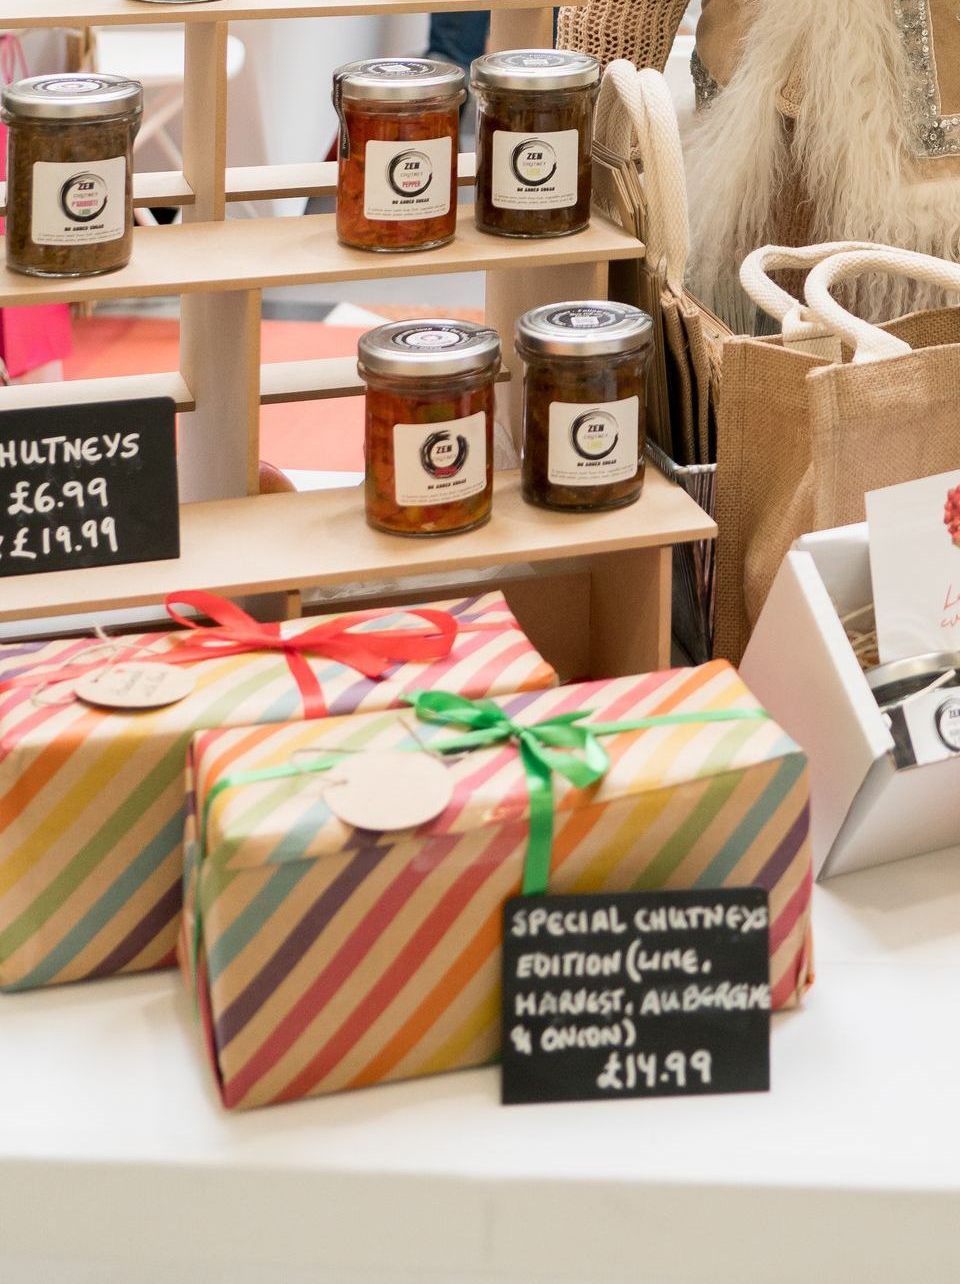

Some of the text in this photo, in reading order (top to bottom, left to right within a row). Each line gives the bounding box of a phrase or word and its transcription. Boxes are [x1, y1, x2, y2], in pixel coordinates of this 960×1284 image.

[527, 152, 543, 160] ZEN
[404, 162, 420, 170] ZEN
[78, 182, 95, 190] ZEN
[588, 424, 604, 433] ZEN
[436, 445, 452, 454] ZEN
[7, 477, 108, 515] £6.99
[511, 904, 768, 936] SPECIAL CHUTNEYS
[516, 950, 621, 978] EDITION
[596, 1049, 712, 1089] £14.99
